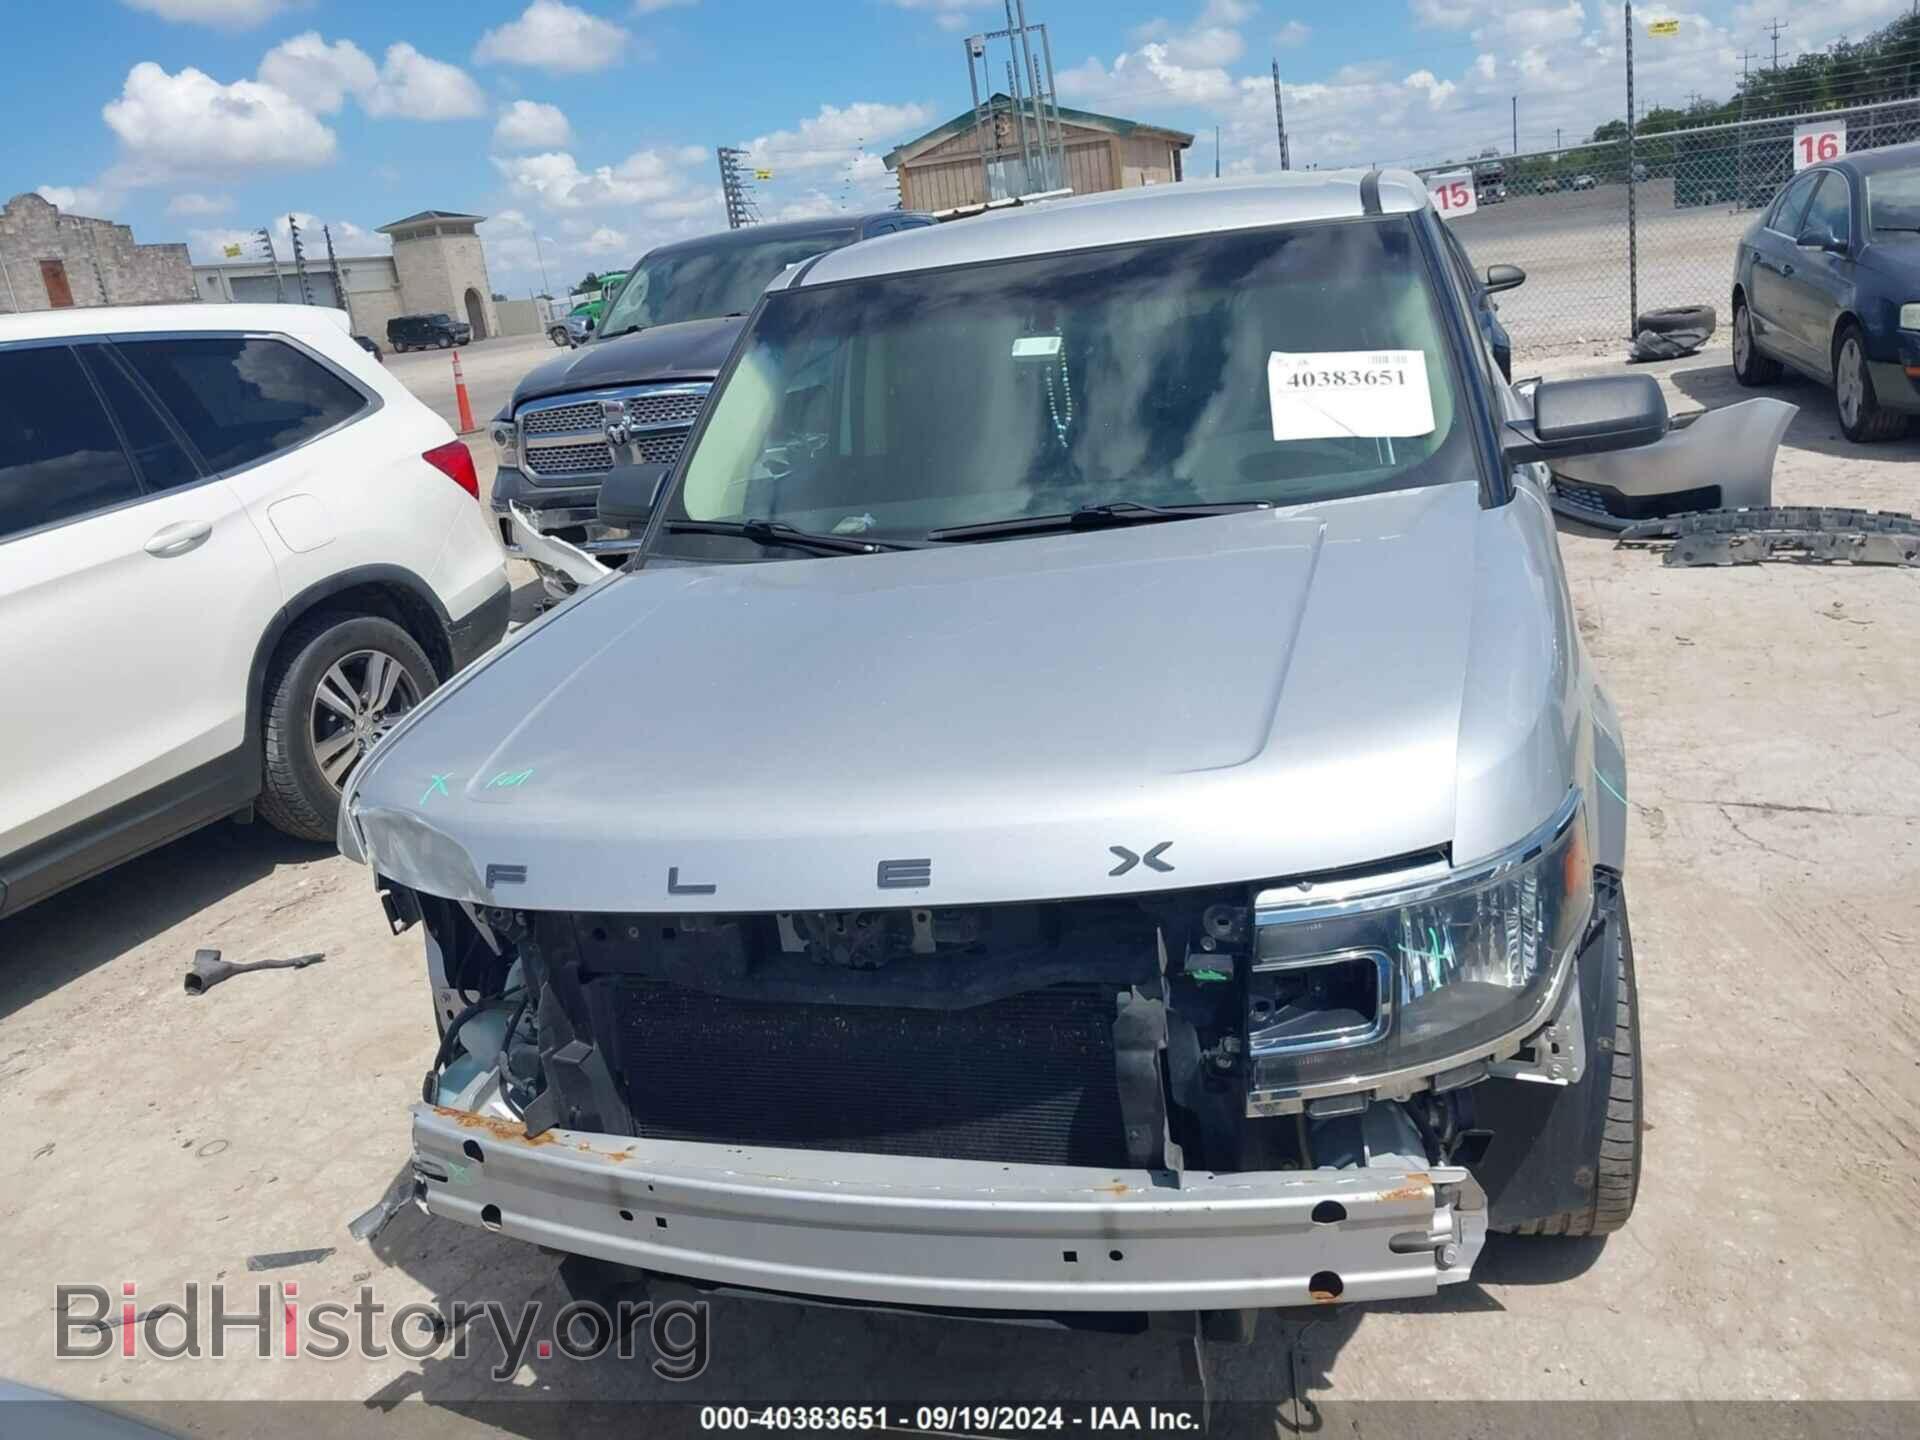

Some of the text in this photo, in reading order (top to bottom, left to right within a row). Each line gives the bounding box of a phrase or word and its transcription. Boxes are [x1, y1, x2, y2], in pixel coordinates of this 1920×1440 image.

[1799, 133, 1838, 163] 16
[1435, 181, 1469, 210] 15
[1287, 369, 1406, 388] 40383651
[486, 841, 1174, 895] FLEX
